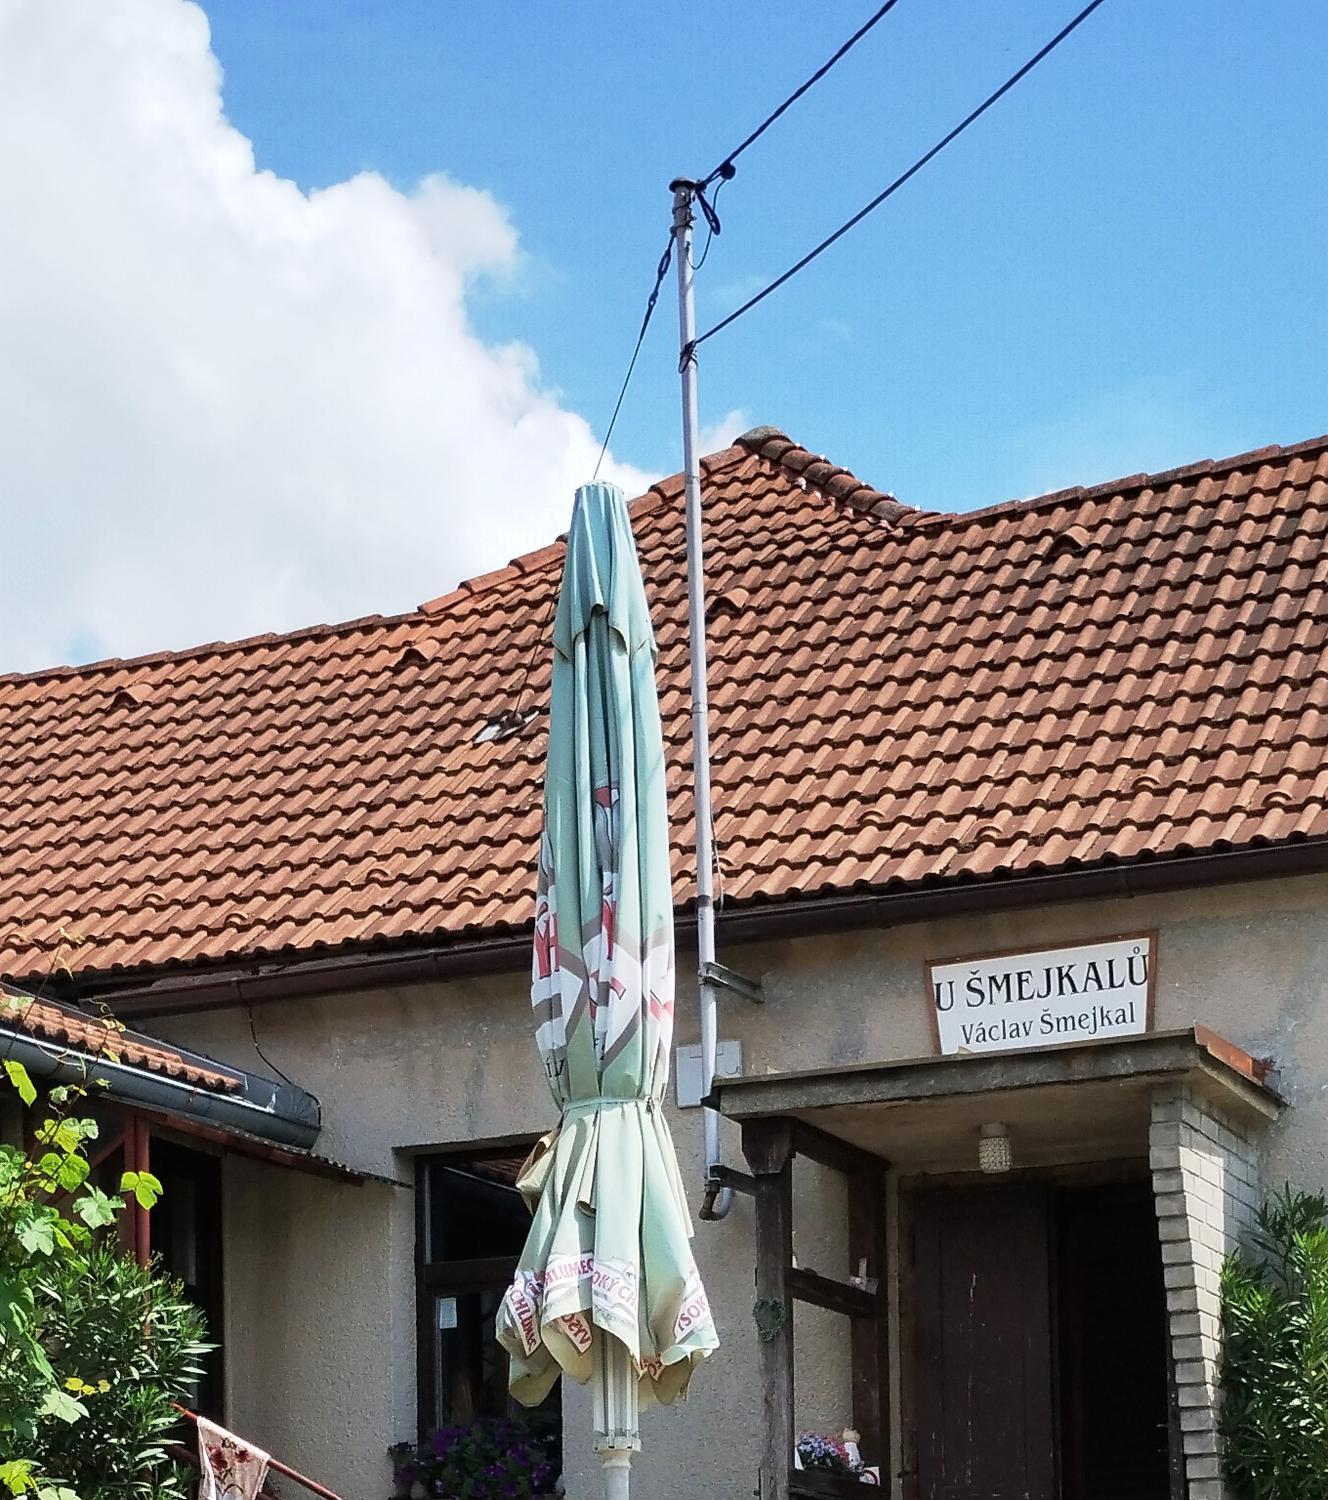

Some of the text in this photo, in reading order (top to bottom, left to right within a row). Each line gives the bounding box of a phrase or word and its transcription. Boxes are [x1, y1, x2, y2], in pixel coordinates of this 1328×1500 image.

[935, 946, 1149, 1011] U ŠMEJKALŮ
[960, 1002, 1135, 1045] Václav Šmejkal
